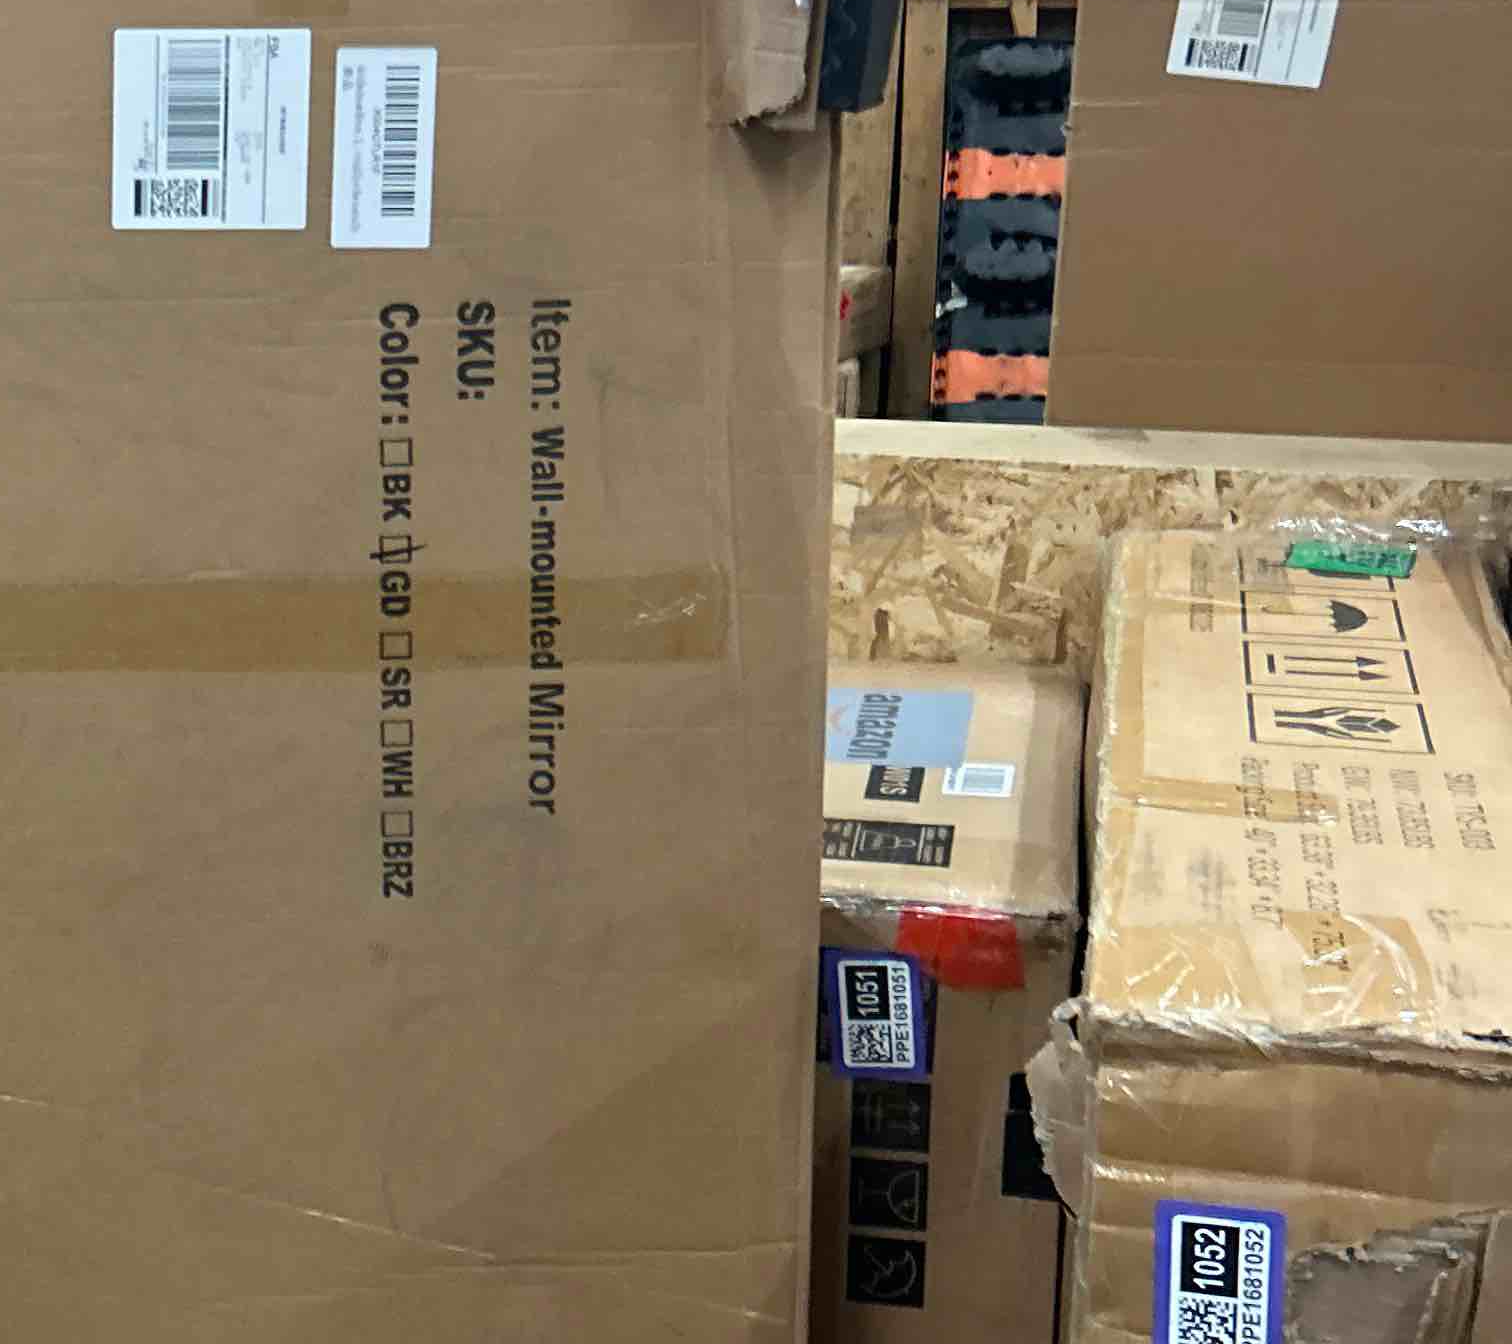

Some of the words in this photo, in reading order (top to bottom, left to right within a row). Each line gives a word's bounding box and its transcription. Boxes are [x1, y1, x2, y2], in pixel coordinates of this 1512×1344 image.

[379, 302, 420, 425] Color:
[456, 300, 496, 401] SKU:
[530, 298, 572, 411] Item:
[382, 474, 412, 522] BK
[530, 427, 565, 671] Wall-mounted
[380, 570, 411, 618] GD
[380, 666, 411, 712] SR
[528, 682, 565, 816] Mirror
[847, 693, 903, 759] amazon
[381, 750, 413, 799] WH
[381, 840, 414, 899] BRZ
[855, 971, 881, 1017] 1051
[892, 967, 910, 1063] PPE1681051
[1192, 1227, 1227, 1290] 1052
